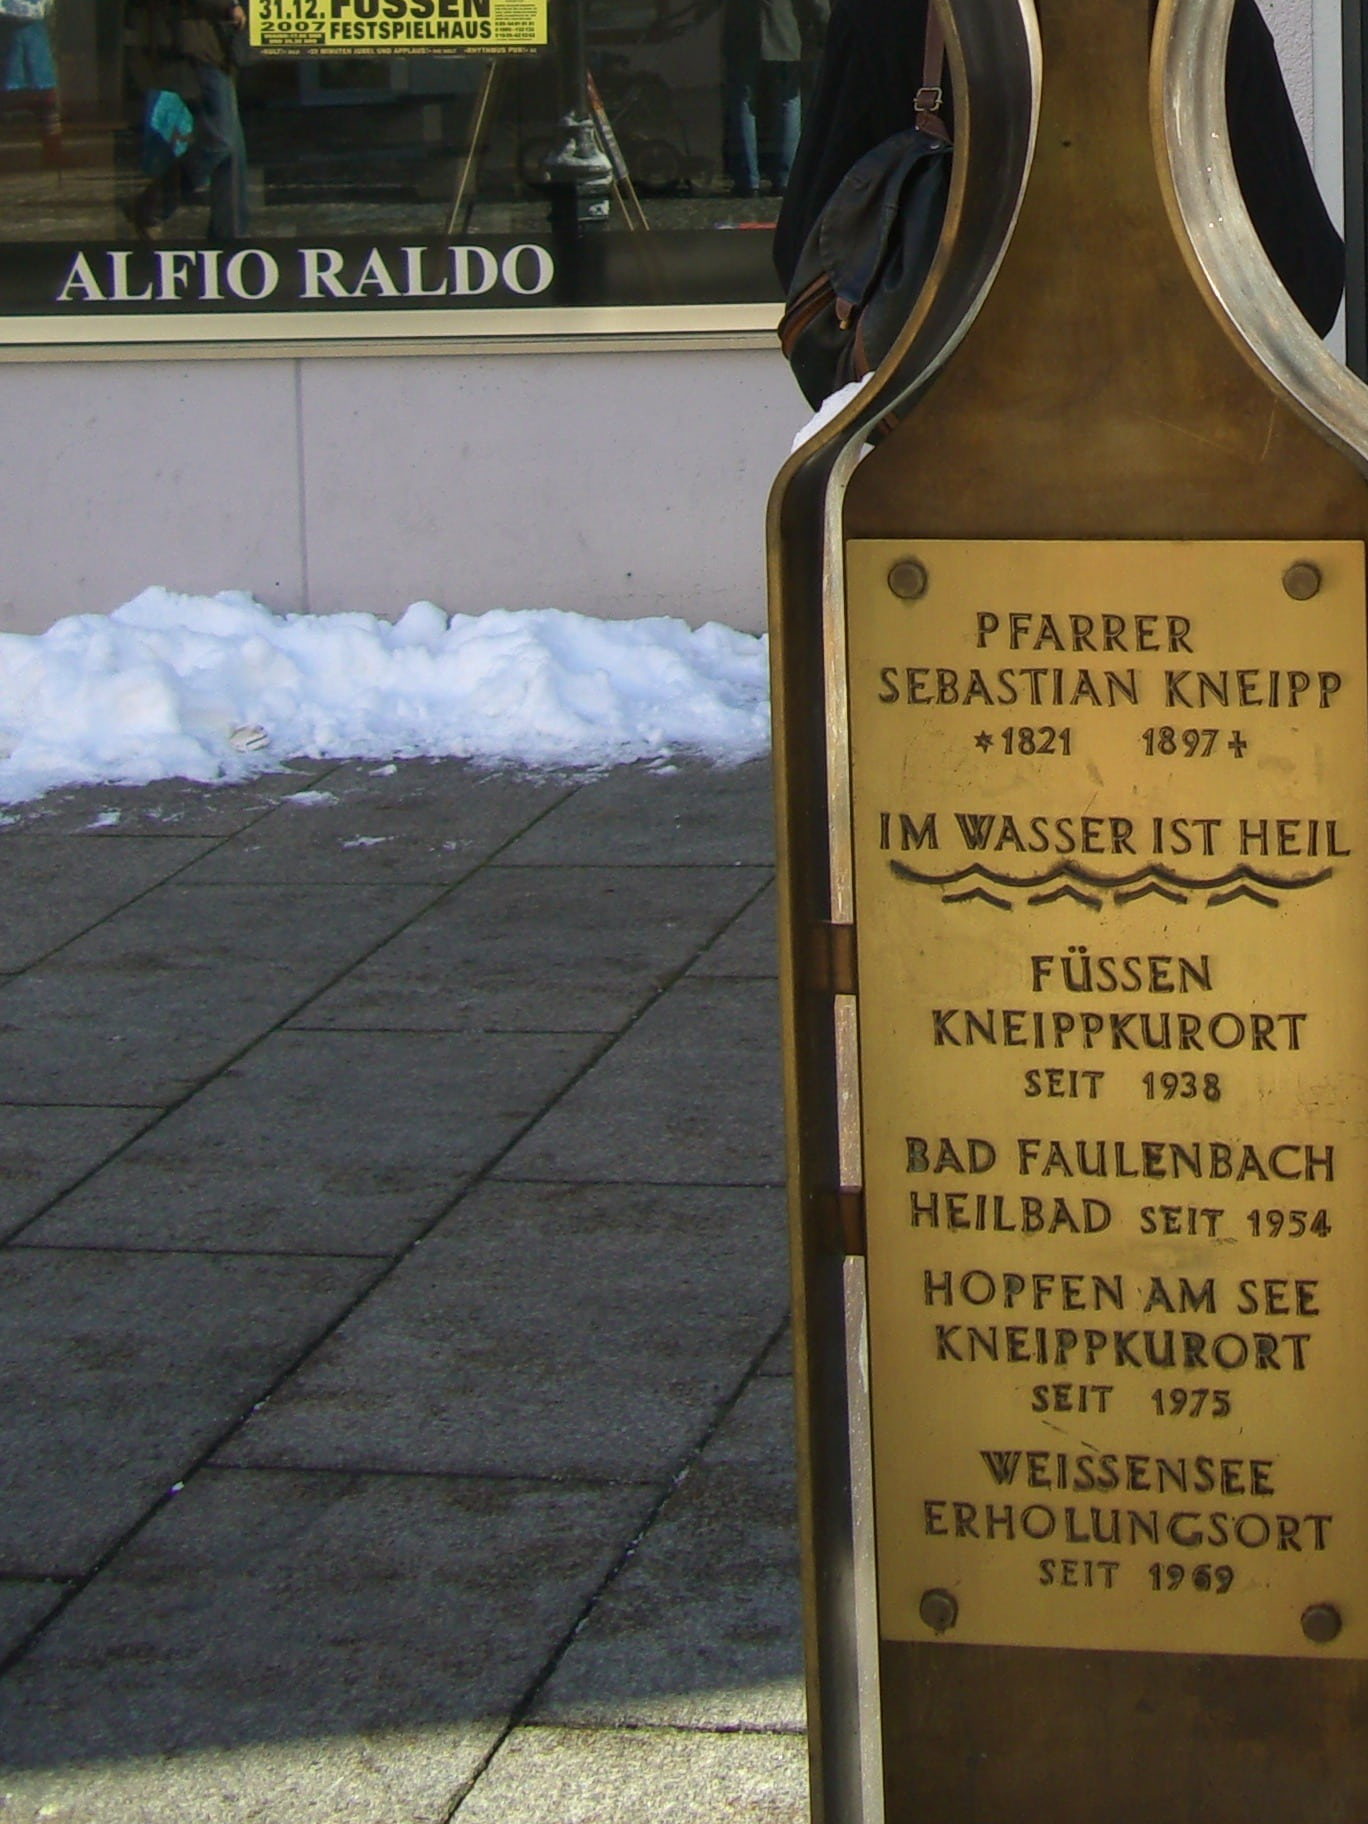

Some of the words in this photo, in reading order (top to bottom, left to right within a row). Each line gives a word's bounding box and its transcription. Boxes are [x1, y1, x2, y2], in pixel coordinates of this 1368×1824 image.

[260, 21, 326, 31] 2007
[330, 21, 492, 40] FESTSPIELHAUS
[56, 247, 279, 302] ALFIO
[298, 242, 556, 299] RALDO
[975, 611, 1195, 654] PFARRER
[877, 667, 1140, 708] SEBASTIAN
[1164, 669, 1344, 710] KNEIPP
[879, 812, 940, 852] IM
[953, 813, 1138, 856] WASSER
[1151, 817, 1222, 856] IST
[1238, 819, 1352, 858] HEIL
[1030, 946, 1214, 994] FÜSSEN
[931, 1008, 1309, 1053] KNEIPPKURORT
[1023, 1069, 1107, 1100] SEIT
[1142, 1070, 1223, 1102] 1938
[904, 1136, 998, 1175] BAD
[1016, 1138, 1337, 1183] FAULENBACH
[909, 1191, 1113, 1235] HEILBAD
[1139, 1205, 1225, 1237] SEIT
[1246, 1208, 1333, 1239] 1954
[923, 1269, 1125, 1312] HOPFEN
[1142, 1276, 1218, 1315] AM
[1236, 1279, 1322, 1317] SEE
[934, 1324, 1312, 1372] KNEIPPKURORT
[1030, 1383, 1114, 1414] SEIT
[1150, 1388, 1232, 1418] 1975
[980, 1449, 1276, 1497] WEISSENSEE
[923, 1499, 1334, 1553] ERHOLUNGSORT
[1038, 1559, 1121, 1590] SEIT
[1147, 1562, 1236, 1595] 1969
